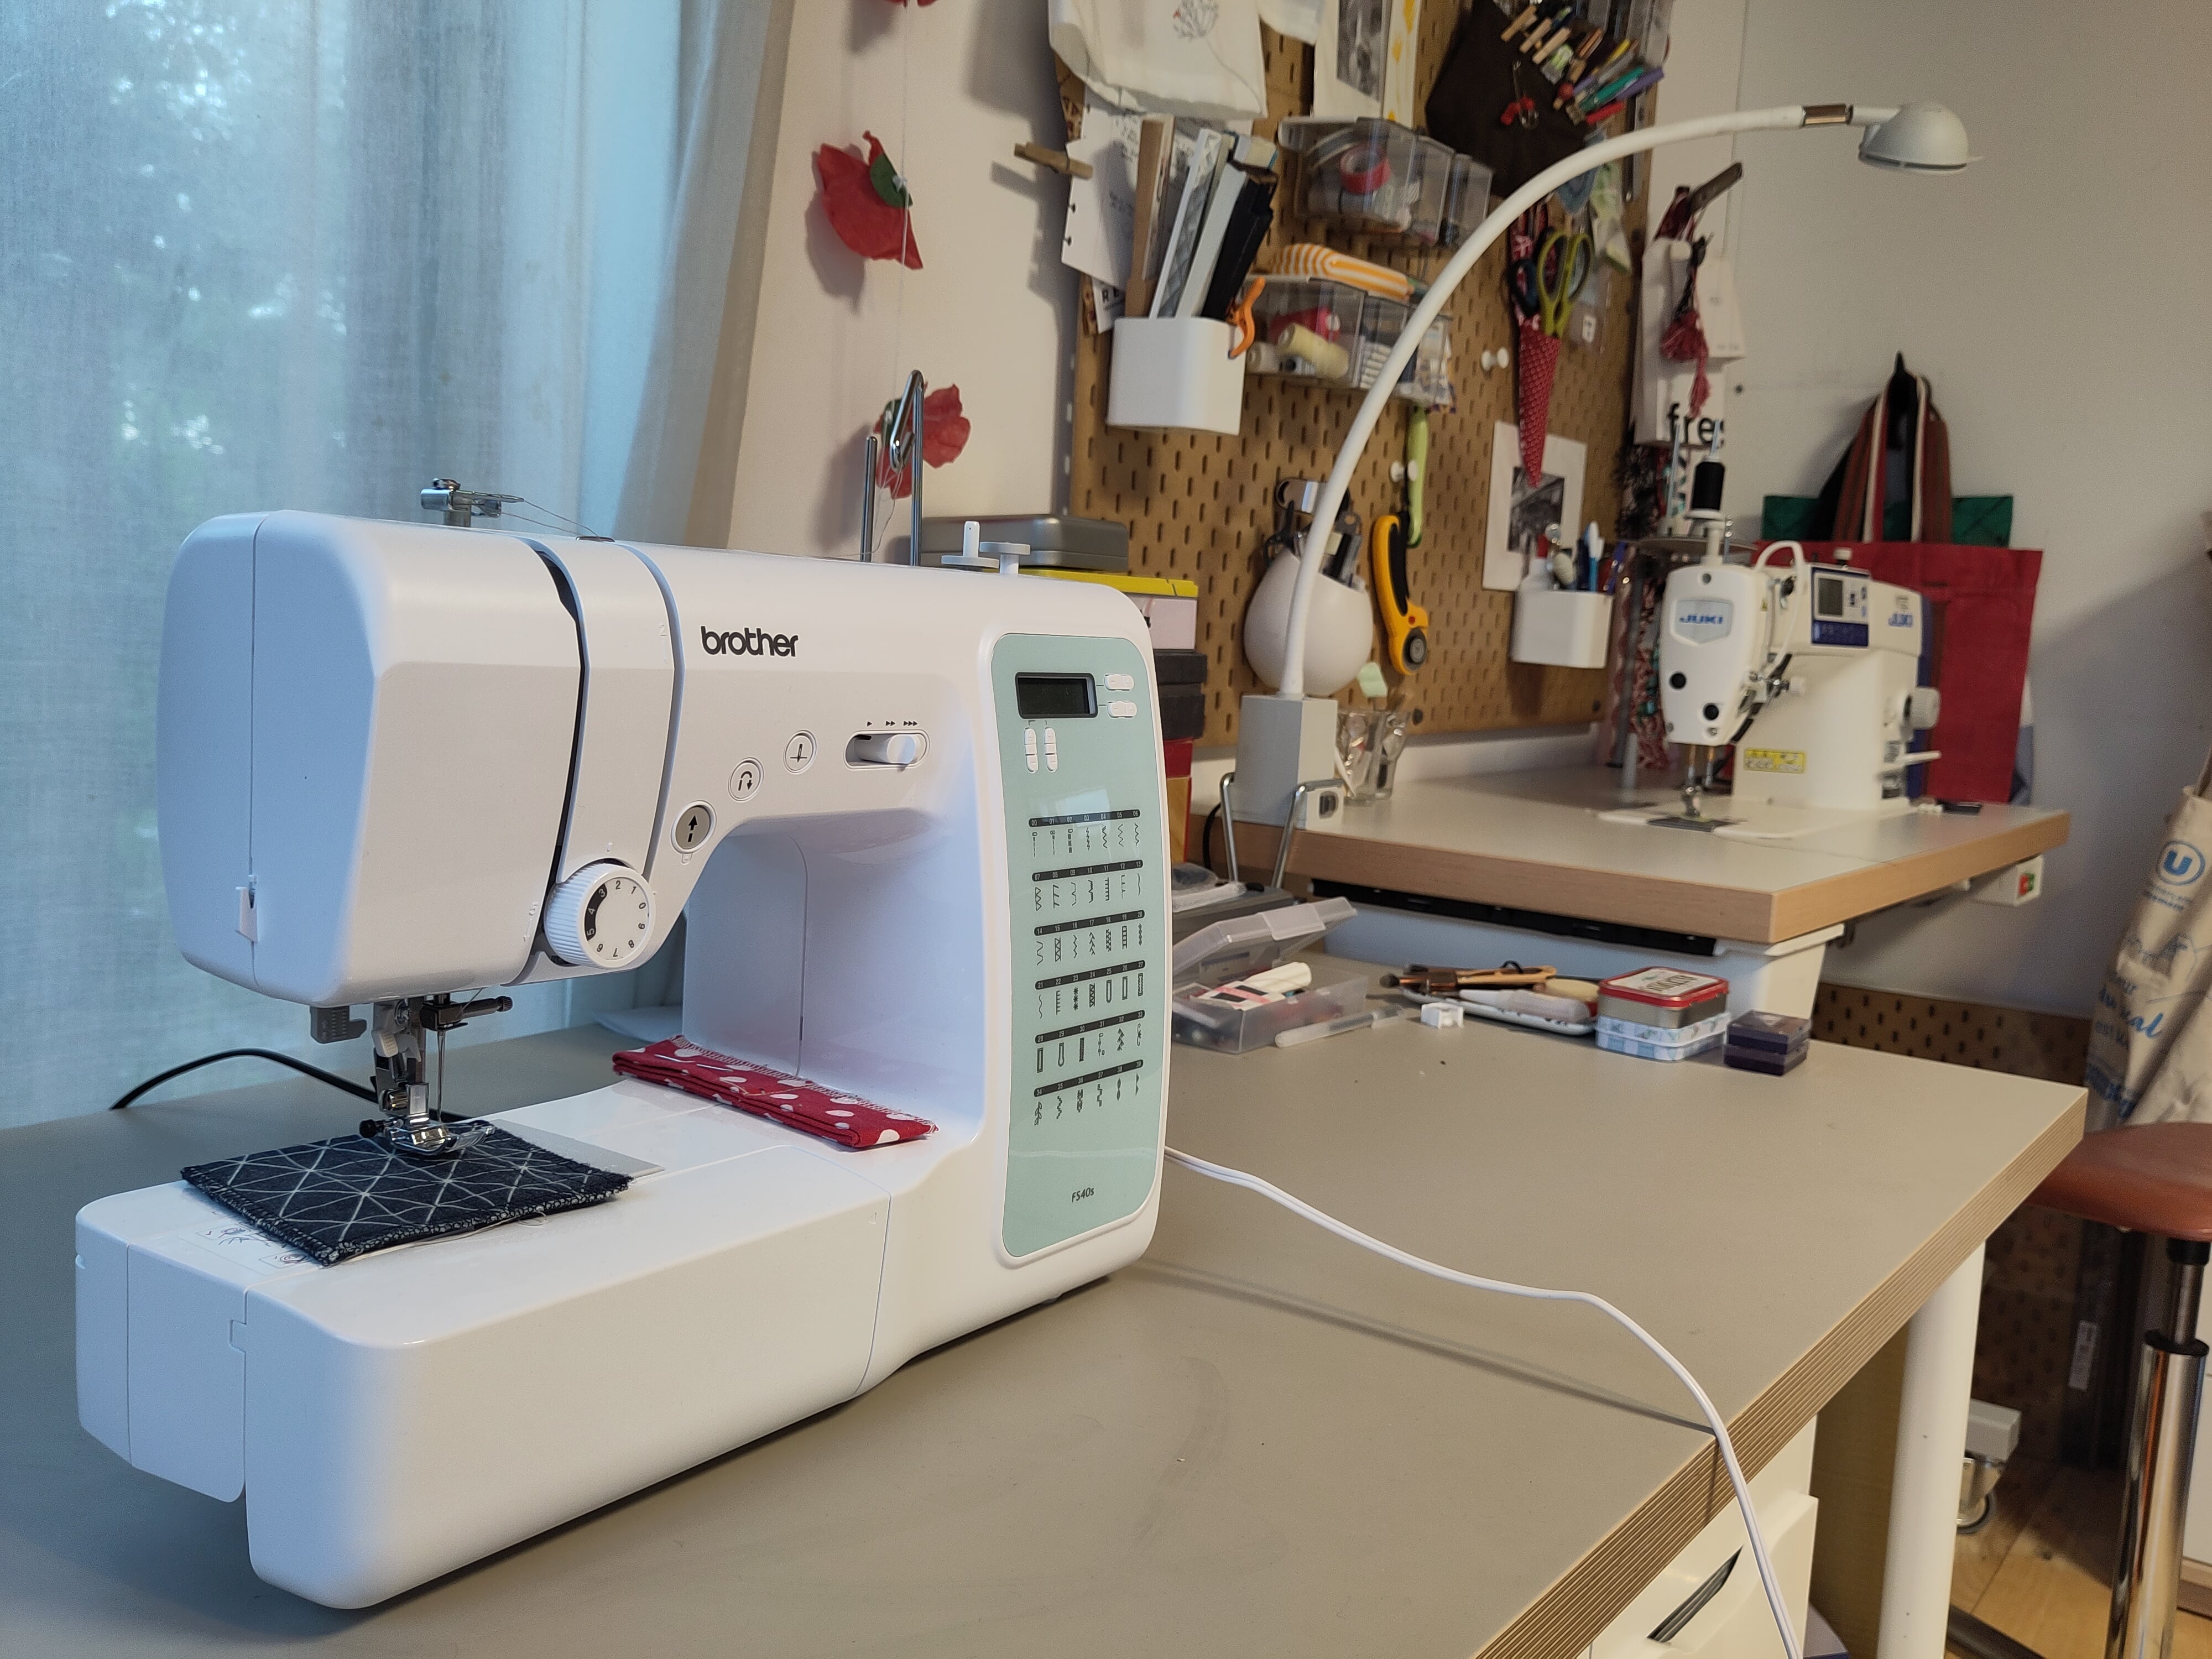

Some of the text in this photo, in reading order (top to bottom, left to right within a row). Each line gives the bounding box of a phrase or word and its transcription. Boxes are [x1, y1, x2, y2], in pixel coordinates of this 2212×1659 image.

[701, 625, 799, 657] brother
[2163, 850, 2193, 875] U
[615, 880, 621, 890] 2
[598, 889, 606, 898] 3
[631, 886, 637, 894] 1
[597, 943, 603, 952] 6
[628, 940, 635, 948] 8
[613, 948, 618, 957] 7
[1072, 1187, 1094, 1203] FS40s
